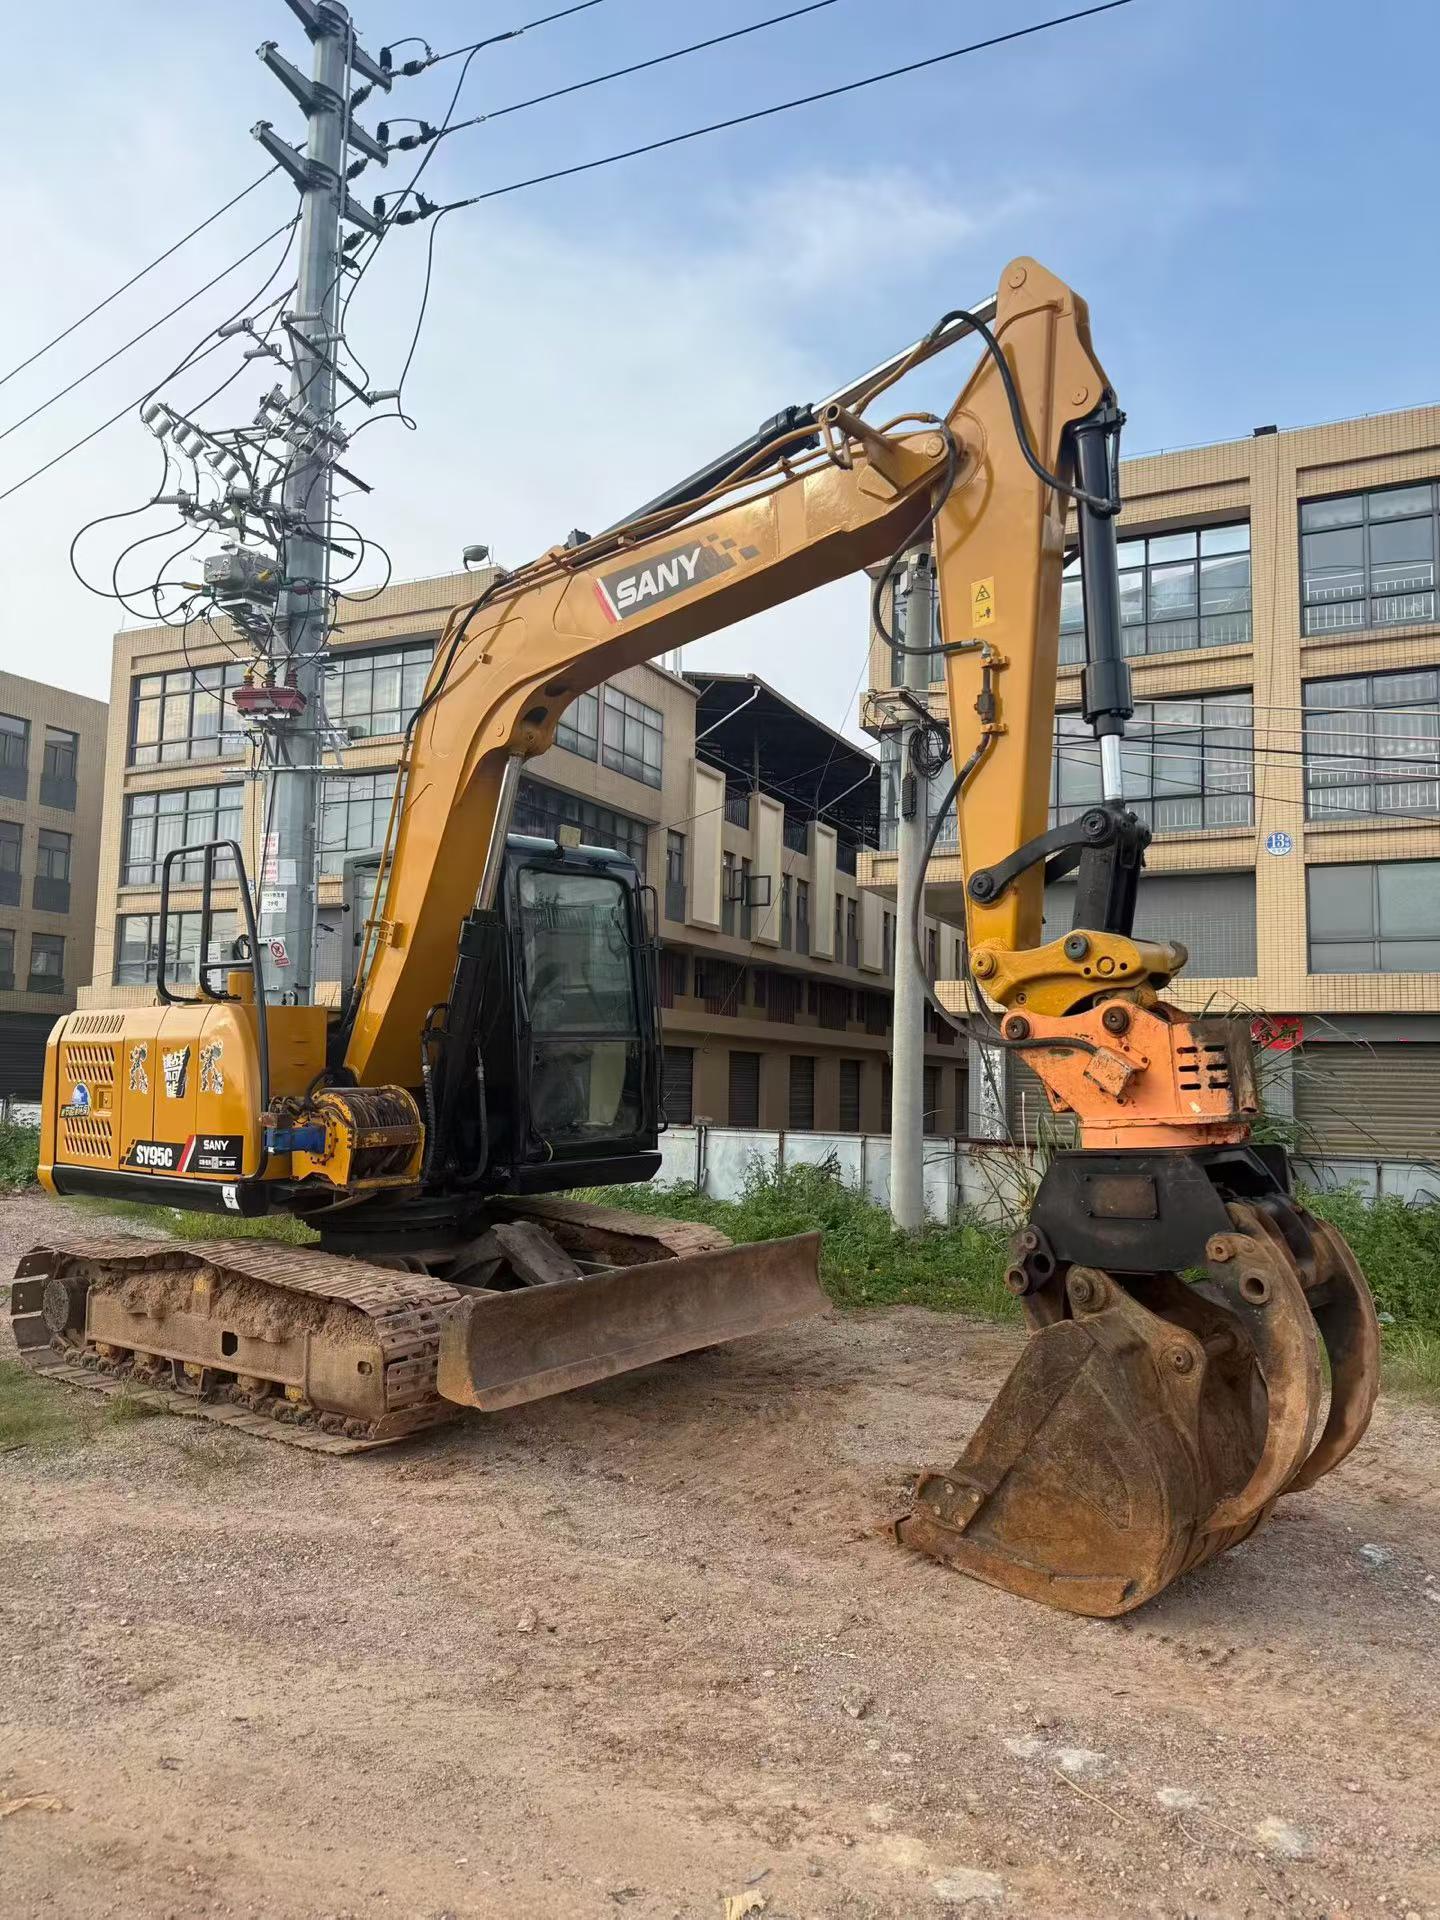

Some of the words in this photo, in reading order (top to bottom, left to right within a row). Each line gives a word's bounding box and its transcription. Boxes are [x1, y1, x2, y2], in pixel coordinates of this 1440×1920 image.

[616, 547, 701, 610] SANY
[1272, 834, 1285, 848] 13
[203, 1139, 229, 1151] SANY
[136, 1144, 173, 1168] SY95C
